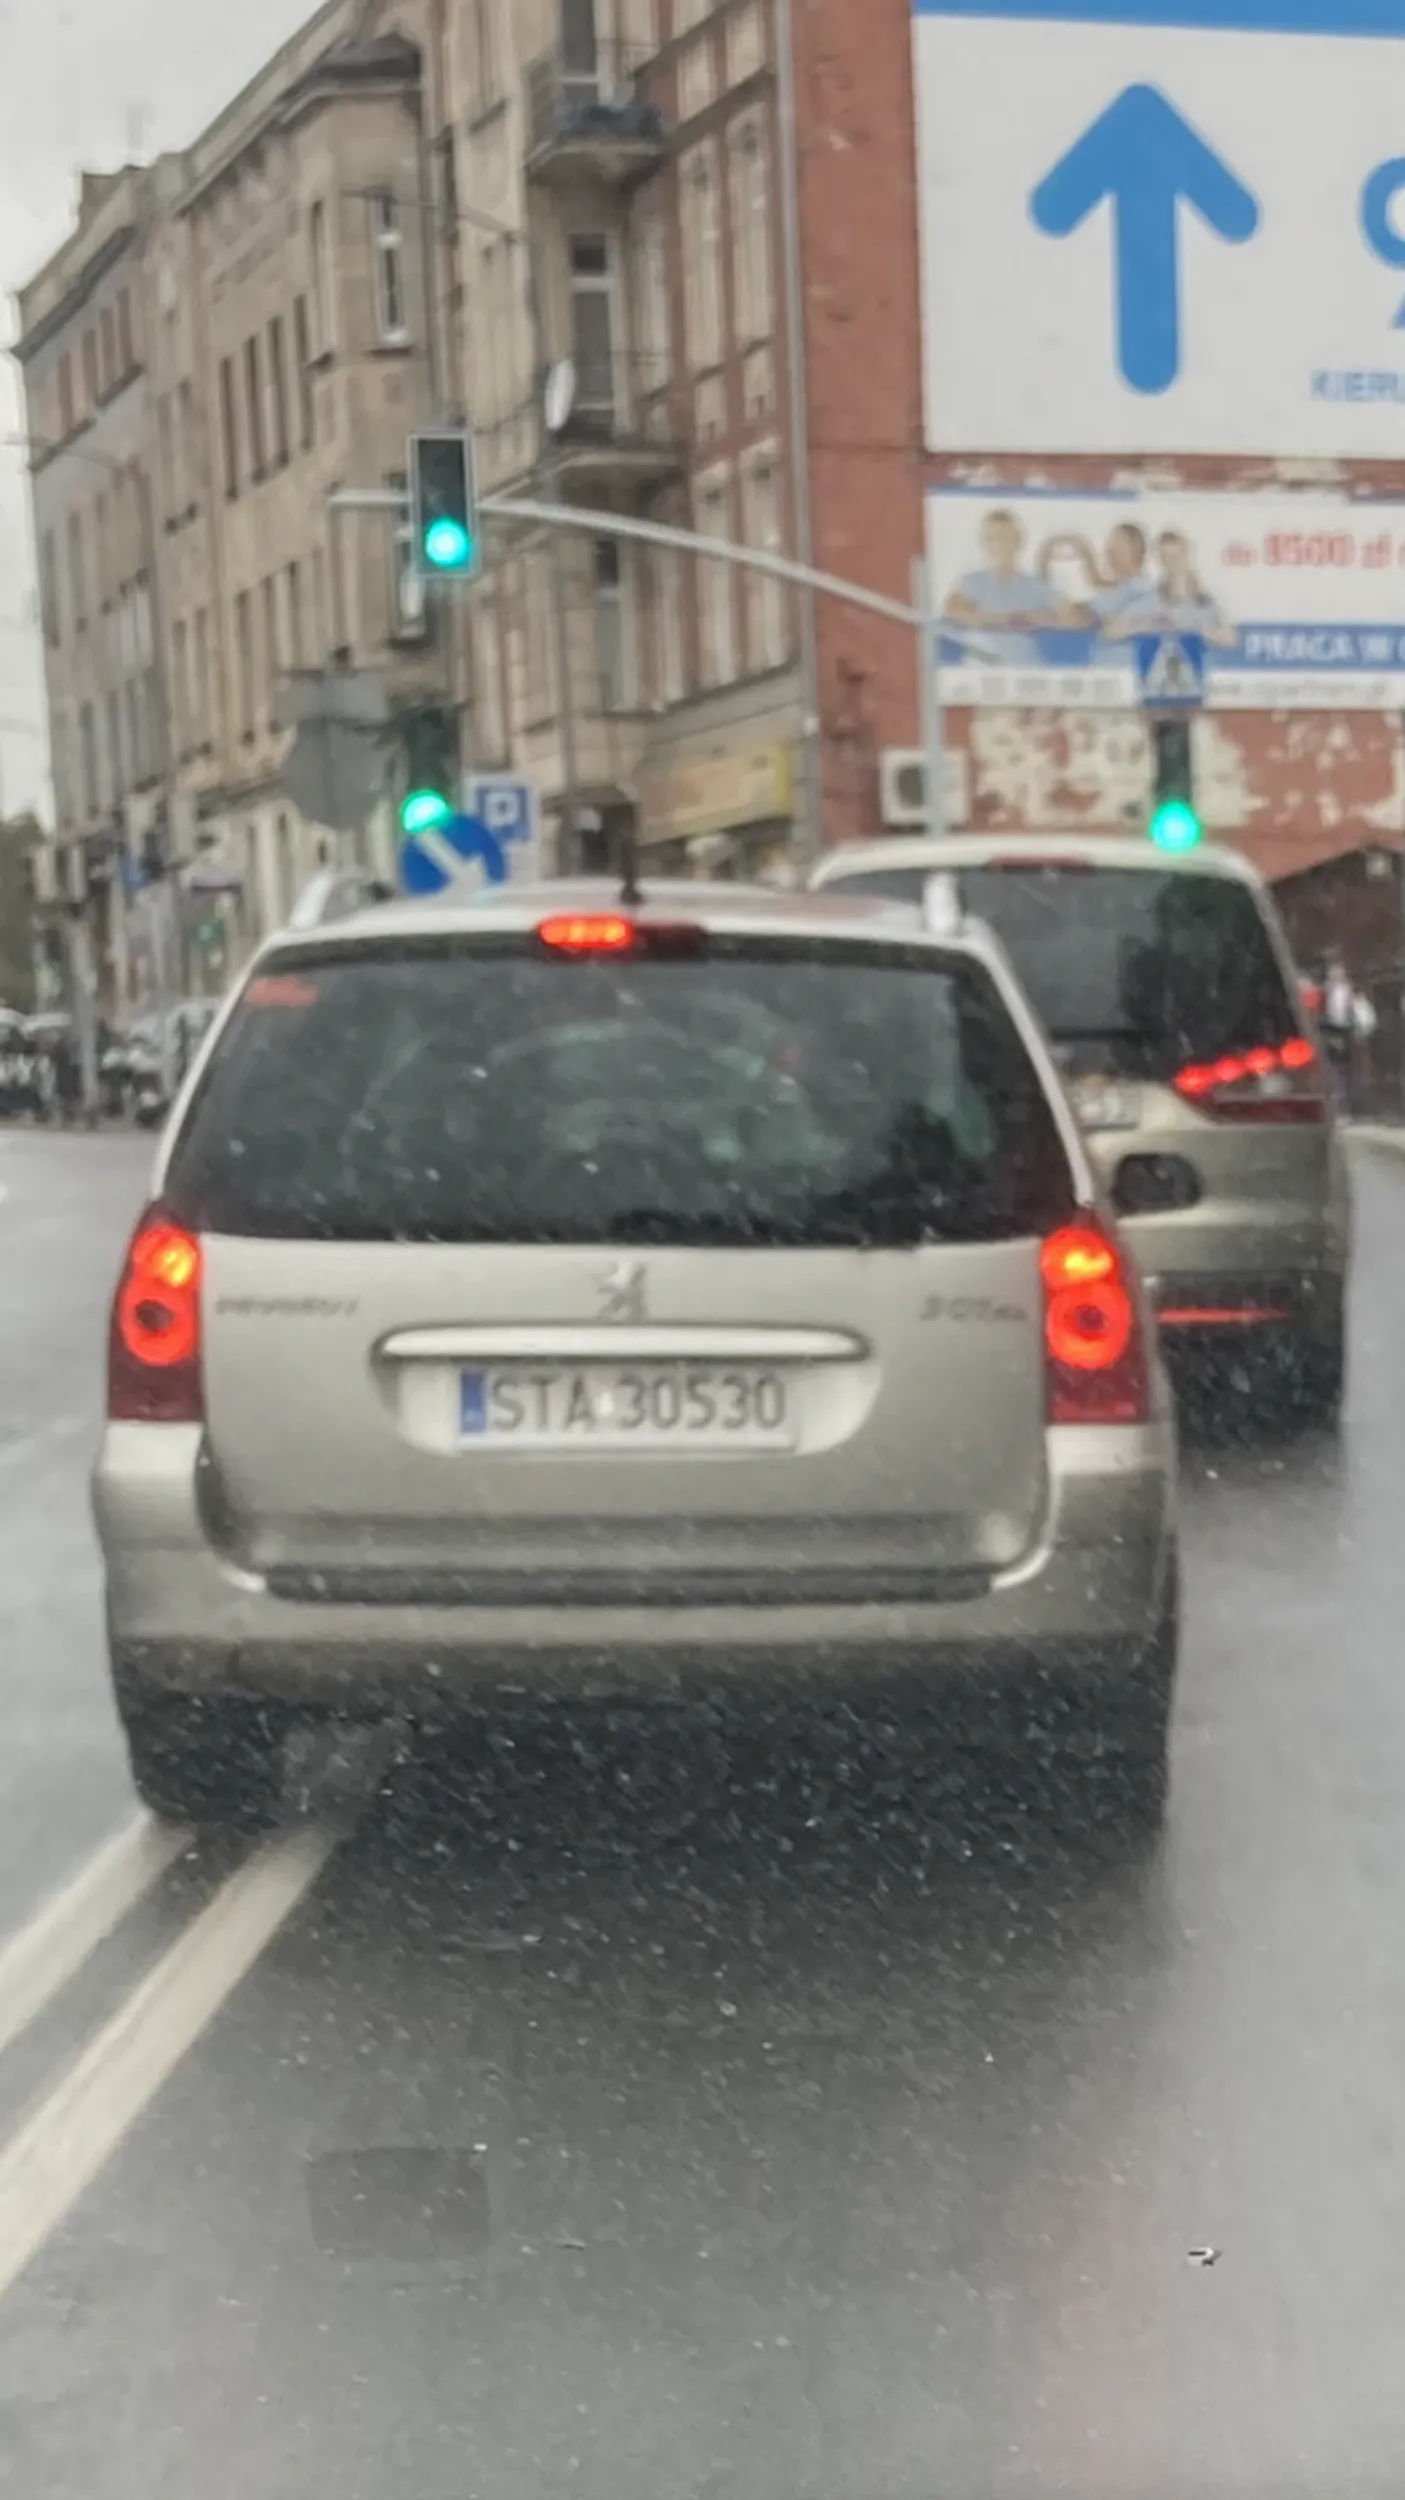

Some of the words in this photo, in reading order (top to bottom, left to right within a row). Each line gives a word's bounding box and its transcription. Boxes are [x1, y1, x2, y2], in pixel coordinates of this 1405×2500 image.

[1245, 632, 1355, 664] PRACA
[485, 791, 518, 829] P
[491, 1373, 597, 1432] STA
[616, 1373, 786, 1431] 30530
